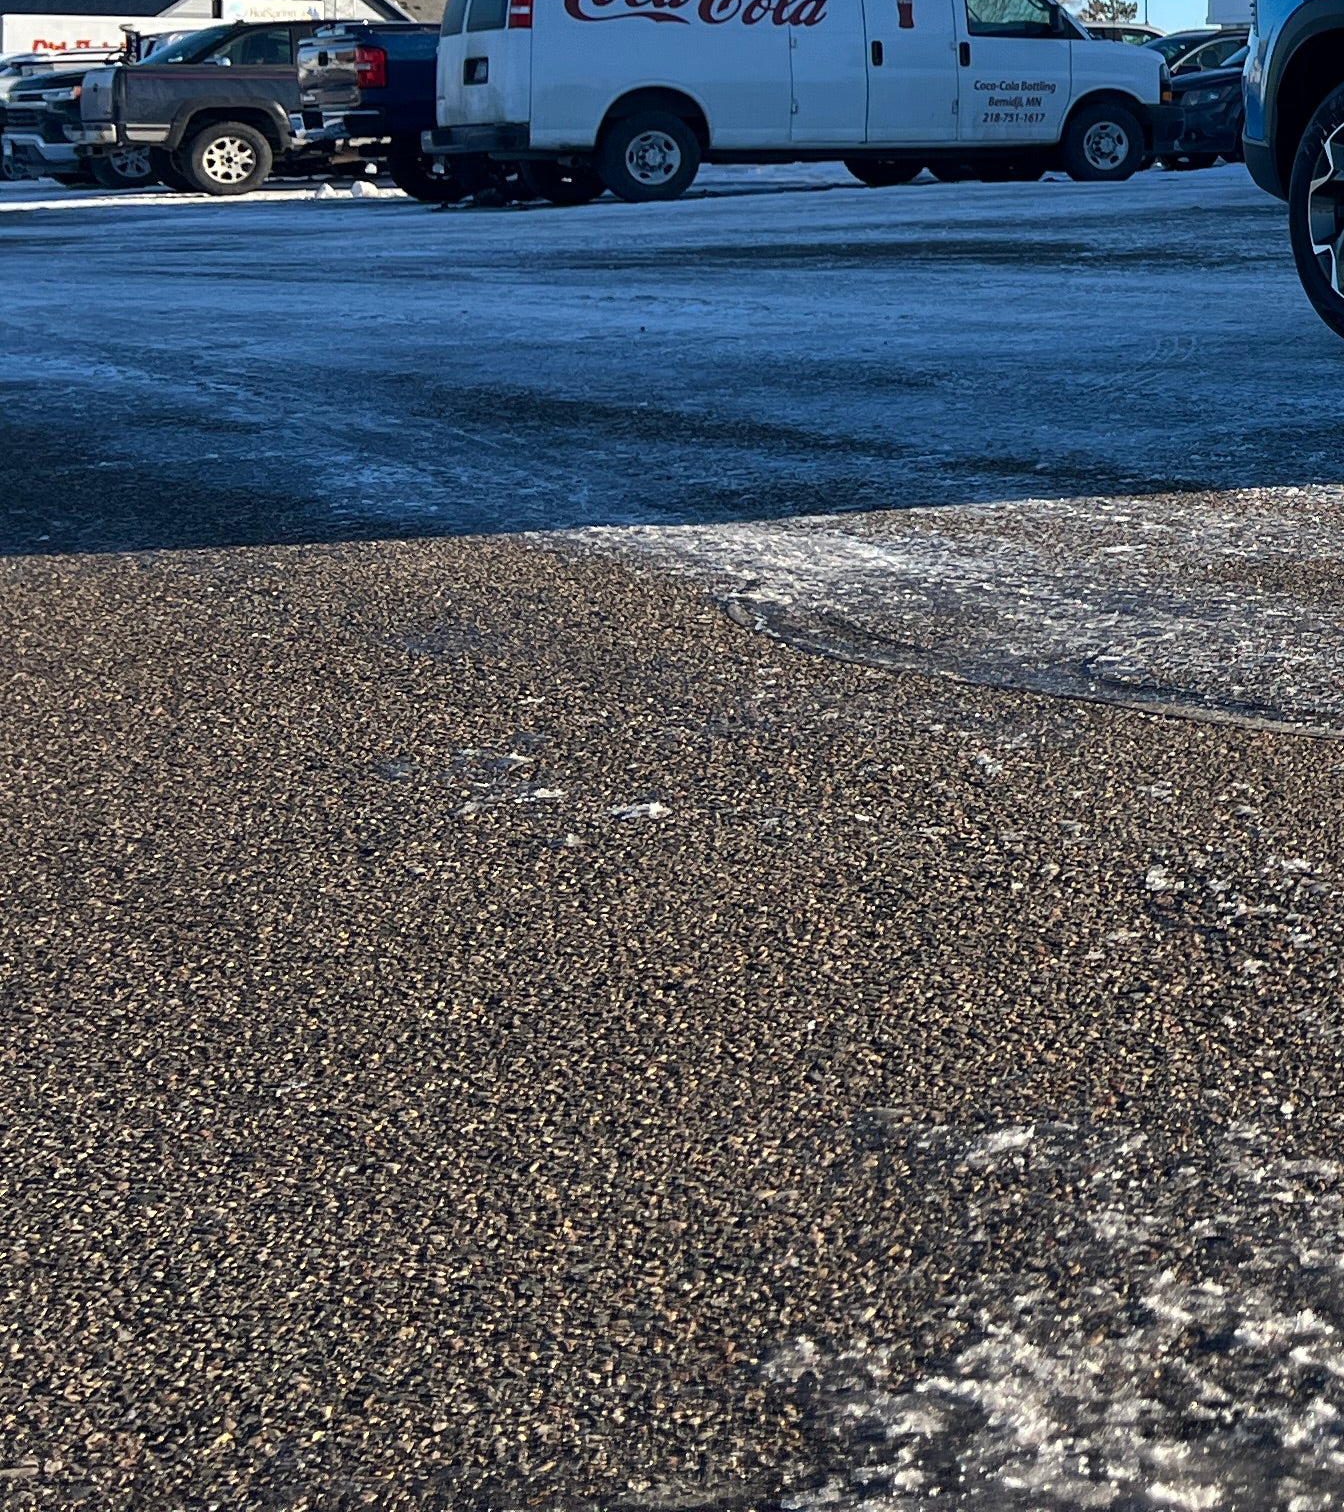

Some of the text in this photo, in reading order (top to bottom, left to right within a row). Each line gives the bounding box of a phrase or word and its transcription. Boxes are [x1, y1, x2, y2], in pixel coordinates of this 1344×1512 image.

[974, 80, 1056, 94] Coca-Cola Bottling
[1026, 97, 1042, 107] MN
[982, 113, 1046, 123] 218-751-1617
